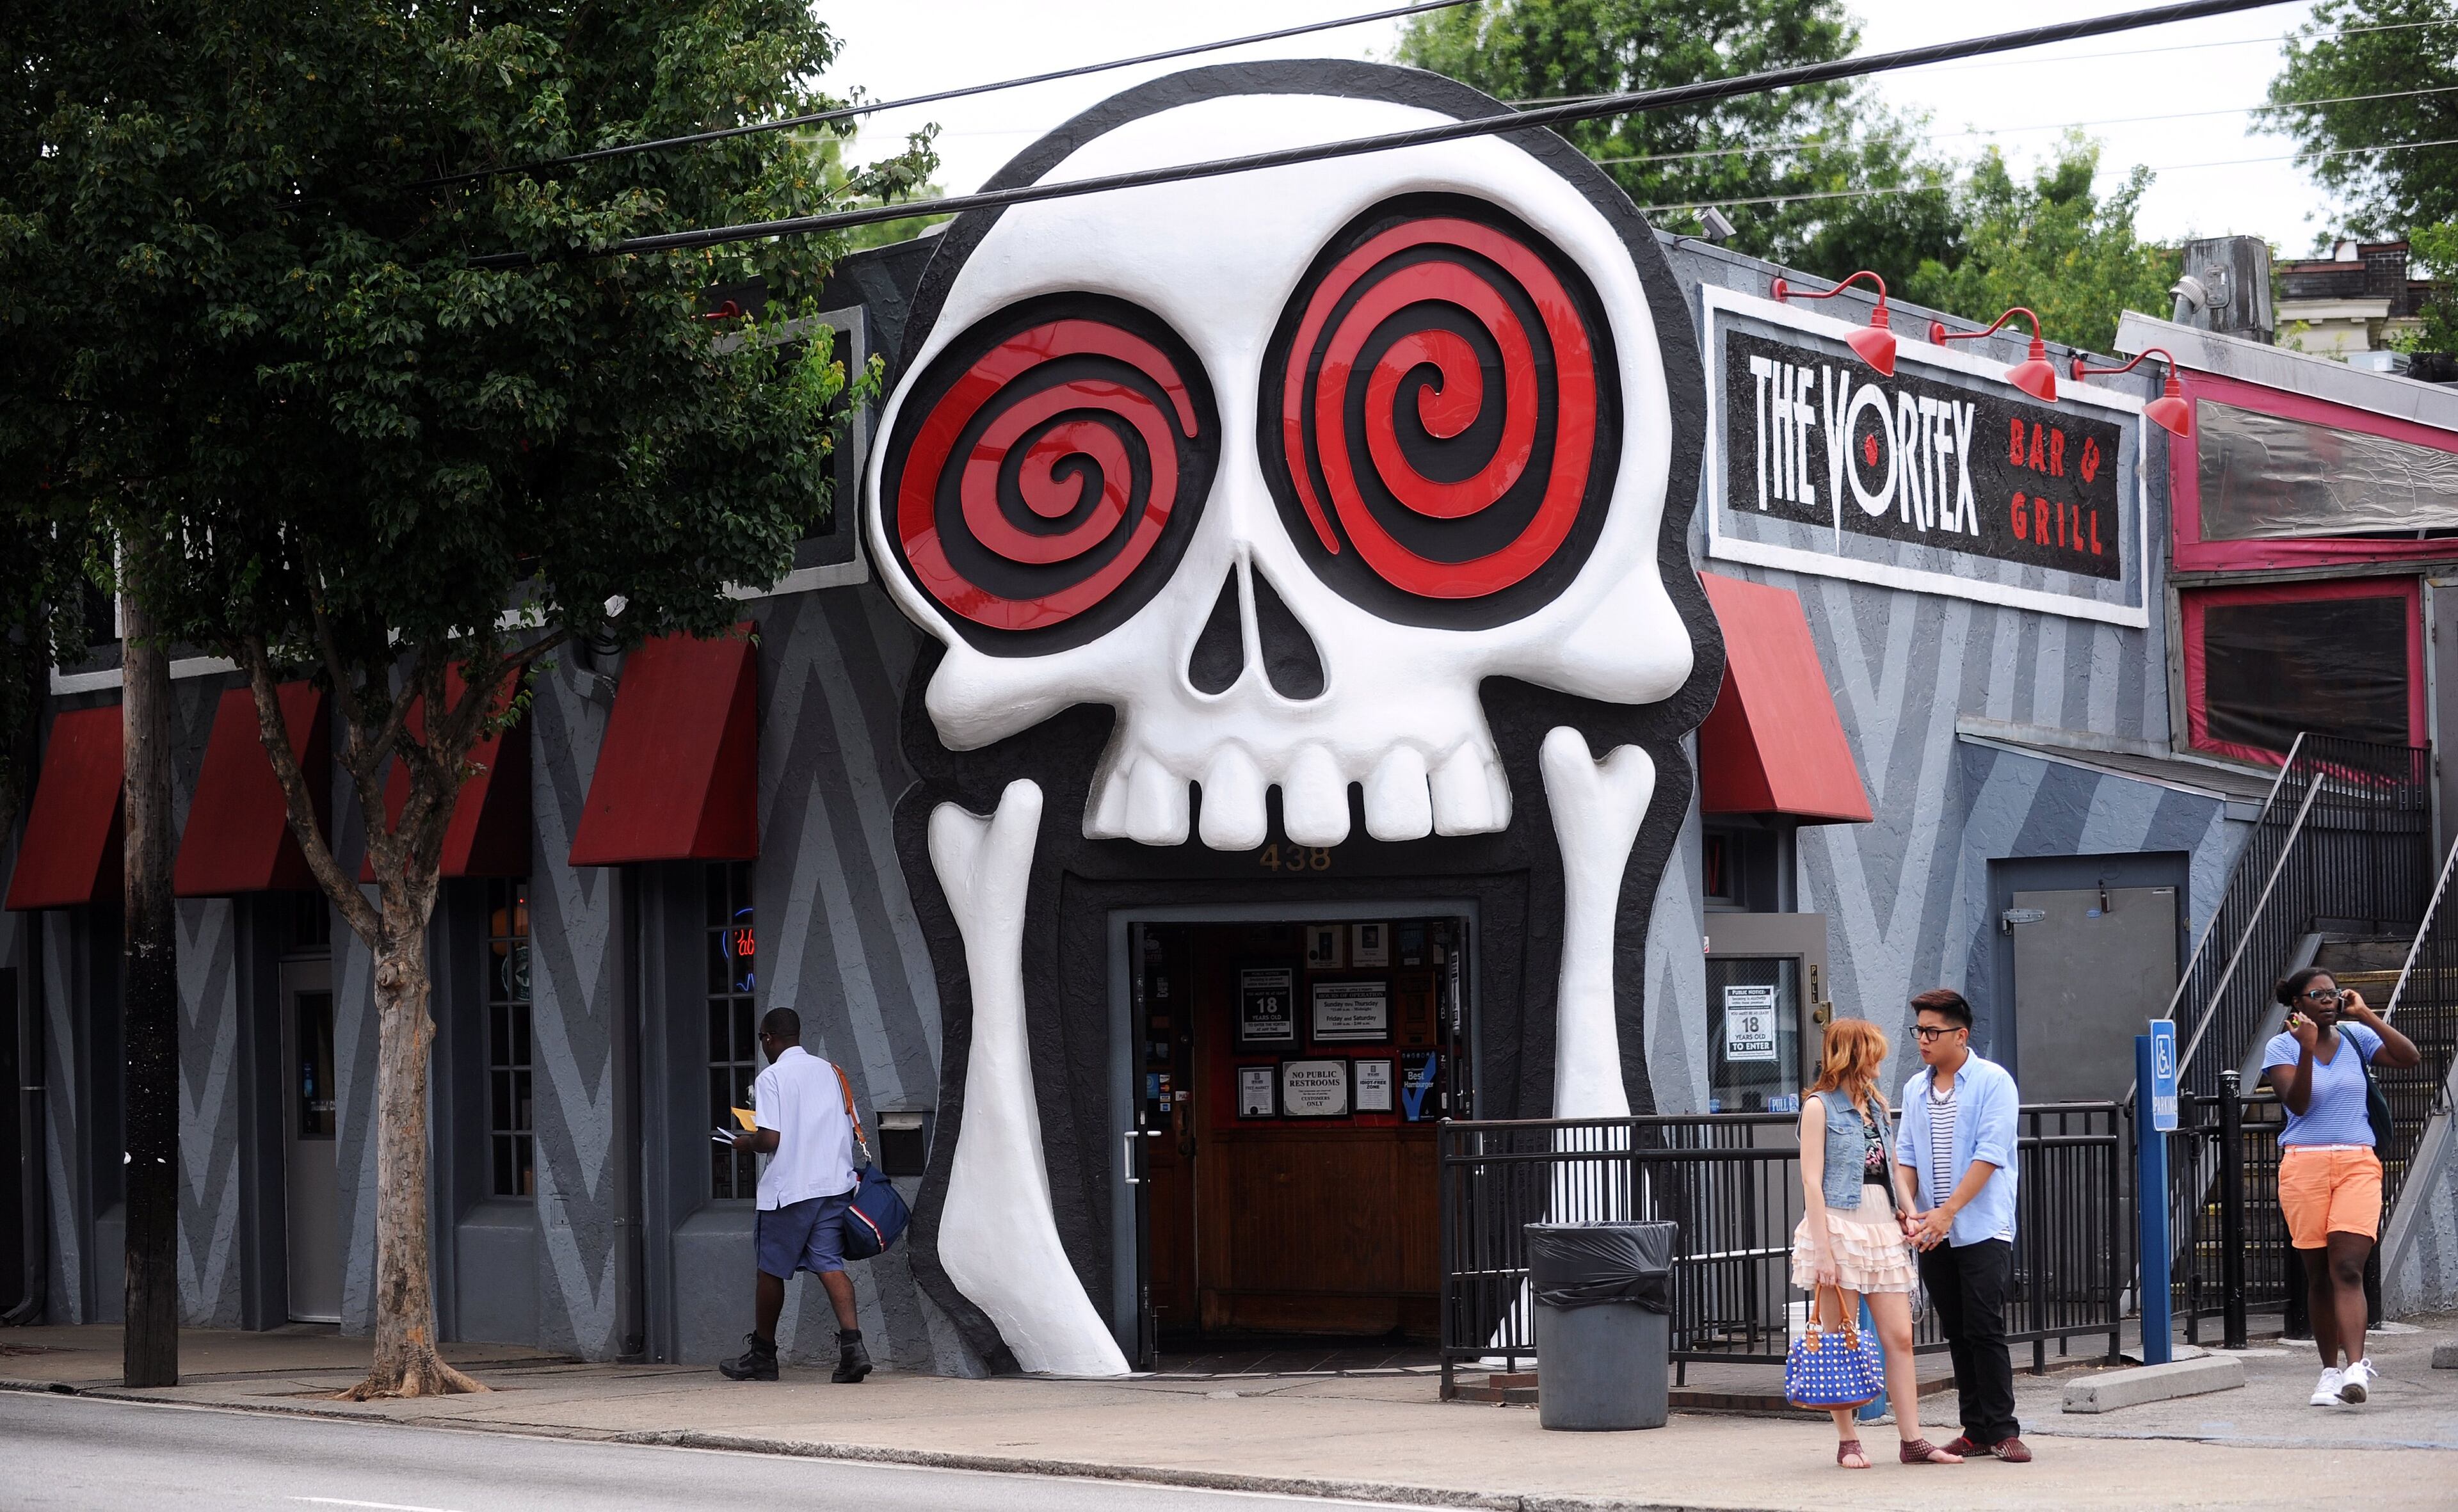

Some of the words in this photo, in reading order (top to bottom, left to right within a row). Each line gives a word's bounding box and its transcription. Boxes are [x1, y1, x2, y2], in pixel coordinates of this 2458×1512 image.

[1749, 355, 1816, 511] THE
[1822, 364, 1979, 556] VORTEX
[2009, 417, 2064, 477] BAR
[2080, 437, 2100, 484] &
[2011, 491, 2102, 556] GRILL
[1259, 843, 1332, 871] 438
[1256, 997, 1278, 1013] 18
[1742, 1017, 1759, 1033] 18
[1746, 1042, 1770, 1050] ENTER
[1289, 1079, 1340, 1087] RESTROOMS
[1408, 1071, 1424, 1080] Best
[1404, 1081, 1434, 1090] Hamburger
[1772, 1098, 1788, 1112] PULL
[2155, 1095, 2176, 1116] PARKING
